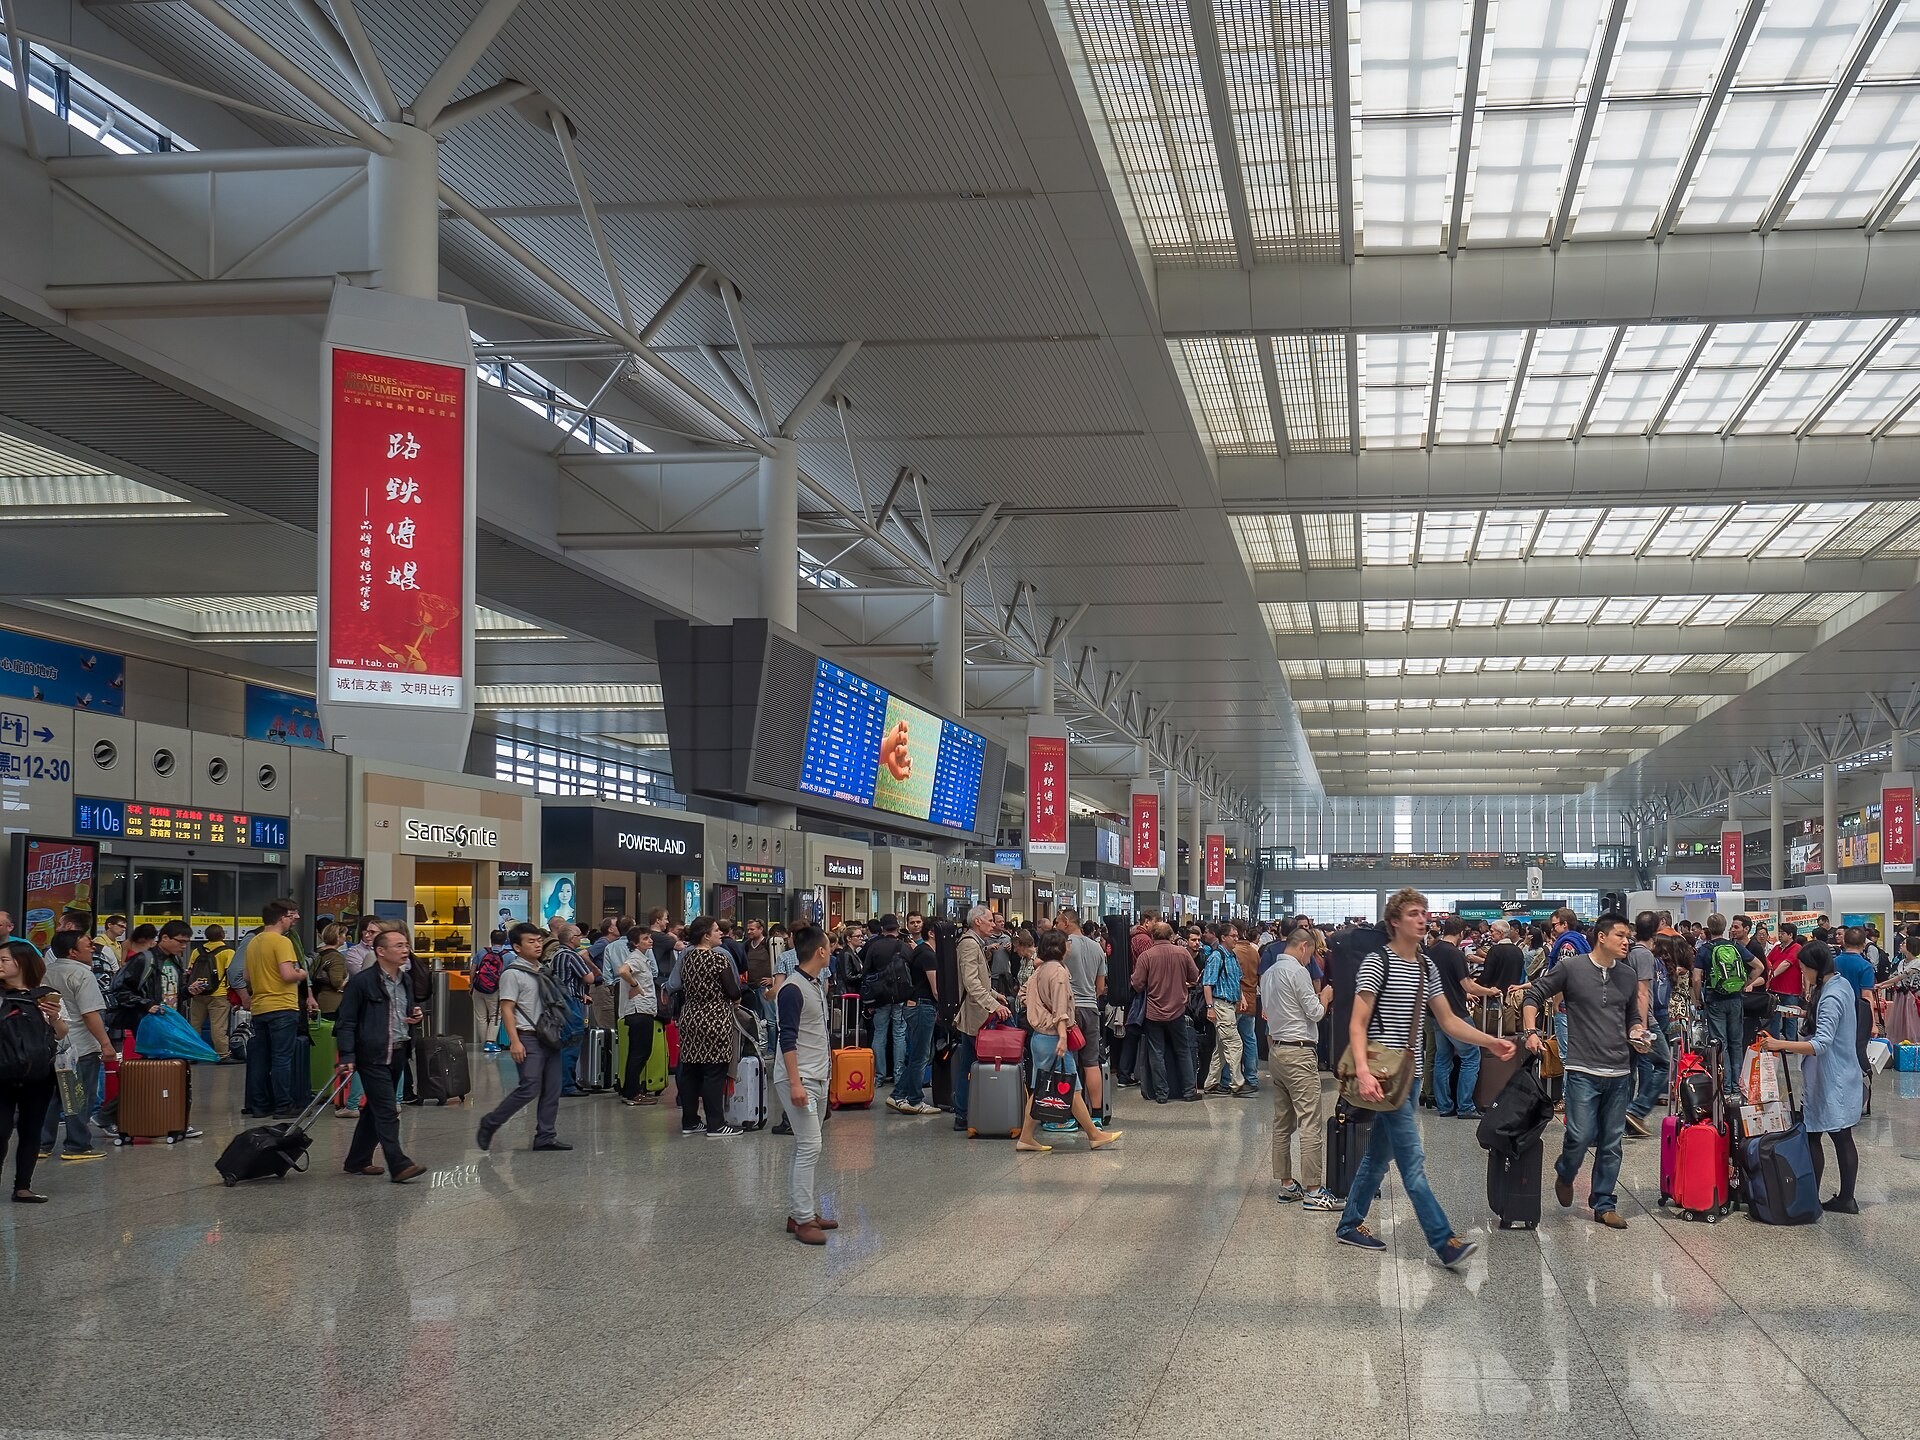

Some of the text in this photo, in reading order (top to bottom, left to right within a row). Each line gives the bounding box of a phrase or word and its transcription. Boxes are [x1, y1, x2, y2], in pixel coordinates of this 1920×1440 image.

[346, 372, 398, 386] TREASURES
[344, 380, 414, 399] MOVEMENT
[416, 390, 432, 401] OF
[434, 392, 457, 405] LIFE
[336, 658, 399, 669] www.ltab.cn
[337, 677, 455, 697] 诚信友善 文明出行
[23, 755, 70, 782] 12-30
[405, 818, 498, 848] Samsonite
[618, 832, 686, 855] POWERLAND
[1685, 880, 1720, 889] 支付宝钱包
[1045, 1080, 1052, 1092] I
